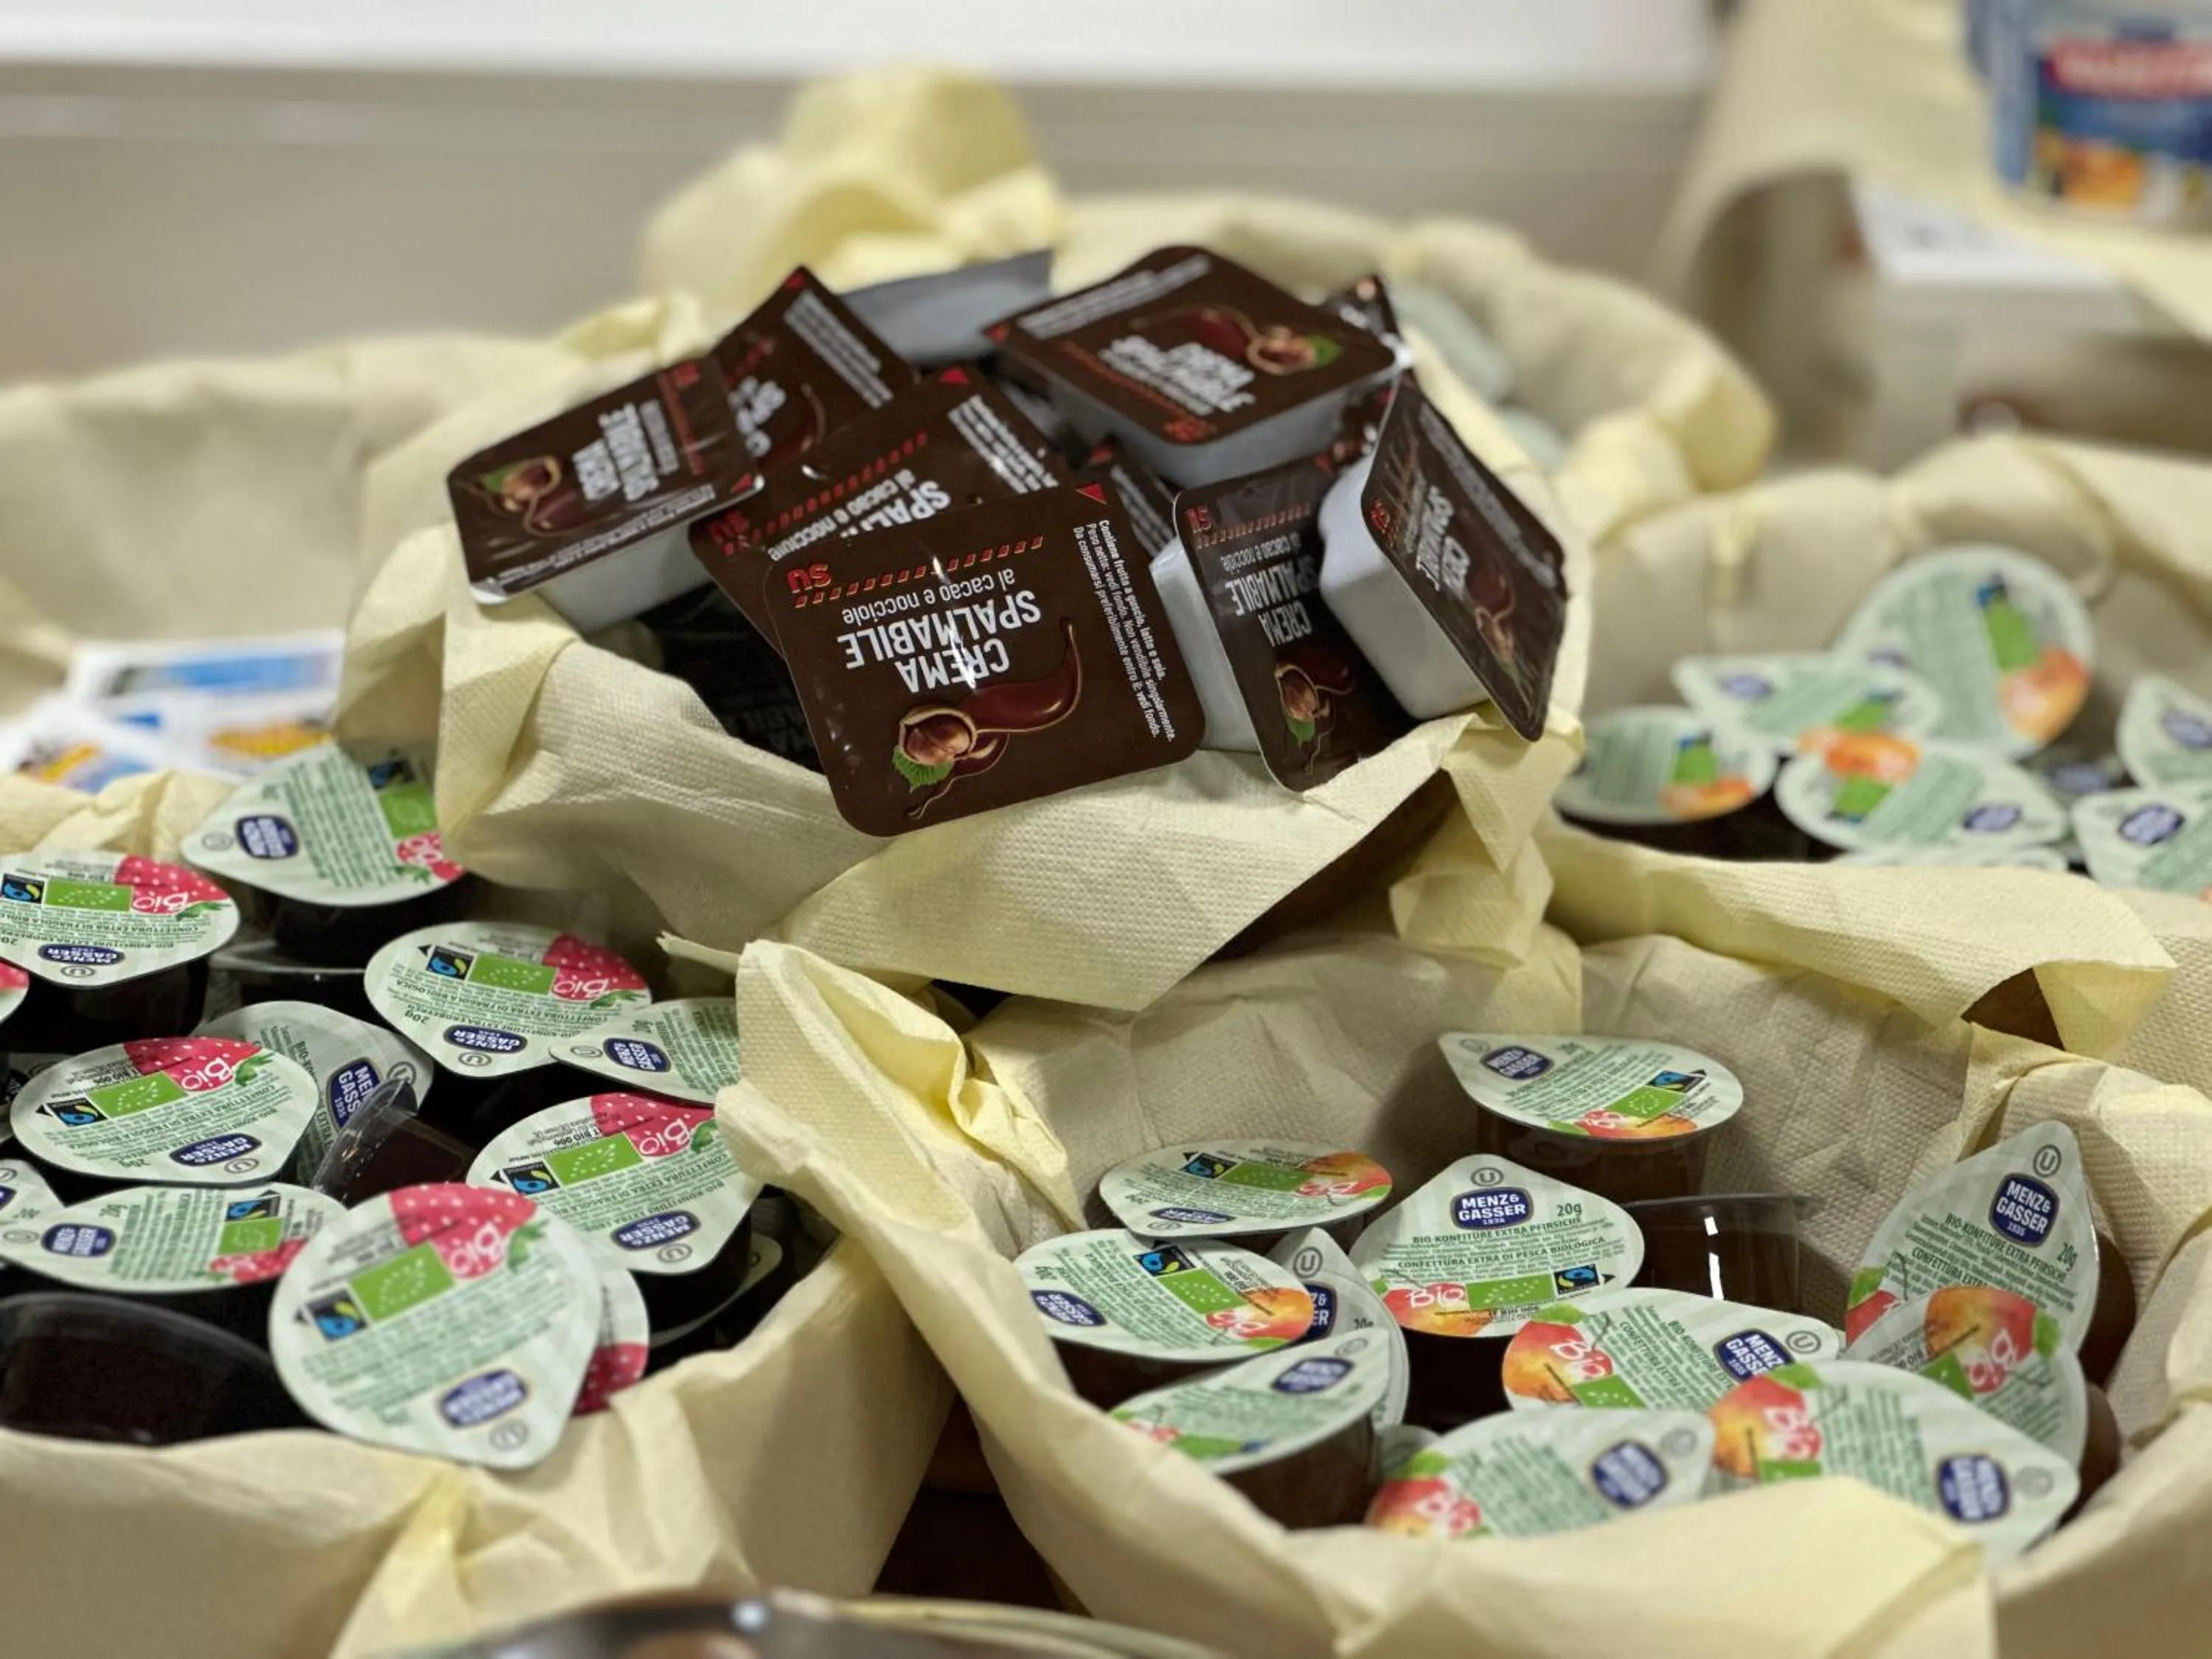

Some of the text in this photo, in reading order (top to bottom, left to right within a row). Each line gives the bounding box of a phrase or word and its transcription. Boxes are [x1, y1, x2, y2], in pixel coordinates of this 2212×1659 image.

[1072, 525, 1085, 539] Da
[786, 563, 832, 593] SU
[1077, 539, 1104, 588] consumarsi
[841, 567, 1017, 629] al cacao e nocciole
[1098, 518, 1121, 560] Contiene
[1113, 558, 1131, 586] frutta
[1139, 626, 1156, 650] latte
[1224, 554, 1321, 616] SPALMABILE
[836, 587, 1043, 671] SPALMABILE
[1095, 588, 1130, 657] preferibilmente
[1256, 599, 1313, 647] CREMA
[894, 634, 1011, 697] CREMA
[1121, 655, 1139, 681] entro
[1135, 690, 1150, 709] vedi
[403, 1009, 429, 1024] 20g
[178, 1055, 233, 1094] Bio
[337, 1069, 361, 1114] GASS
[353, 1065, 376, 1102] MEN
[636, 1116, 692, 1158] Bio
[1458, 1201, 1526, 1223] GASSER
[1461, 1189, 1520, 1211] MENZ&
[1555, 1201, 1582, 1218] 20g
[2005, 1180, 2053, 1214] MENZ&
[619, 1212, 689, 1244] GASSER
[1495, 1225, 1527, 1237] EXTRA
[1993, 1194, 2050, 1236] GASSER
[1397, 1258, 1466, 1269] CONFETTURA
[1467, 1253, 1499, 1265] EXTRA
[1549, 1236, 1605, 1253] BIOLOGICA
[1910, 1245, 1964, 1281] CONFETTURA
[2003, 1242, 2031, 1265] EXTRA
[1405, 1286, 1467, 1310] Bio
[1744, 1333, 1784, 1368] MENZ
